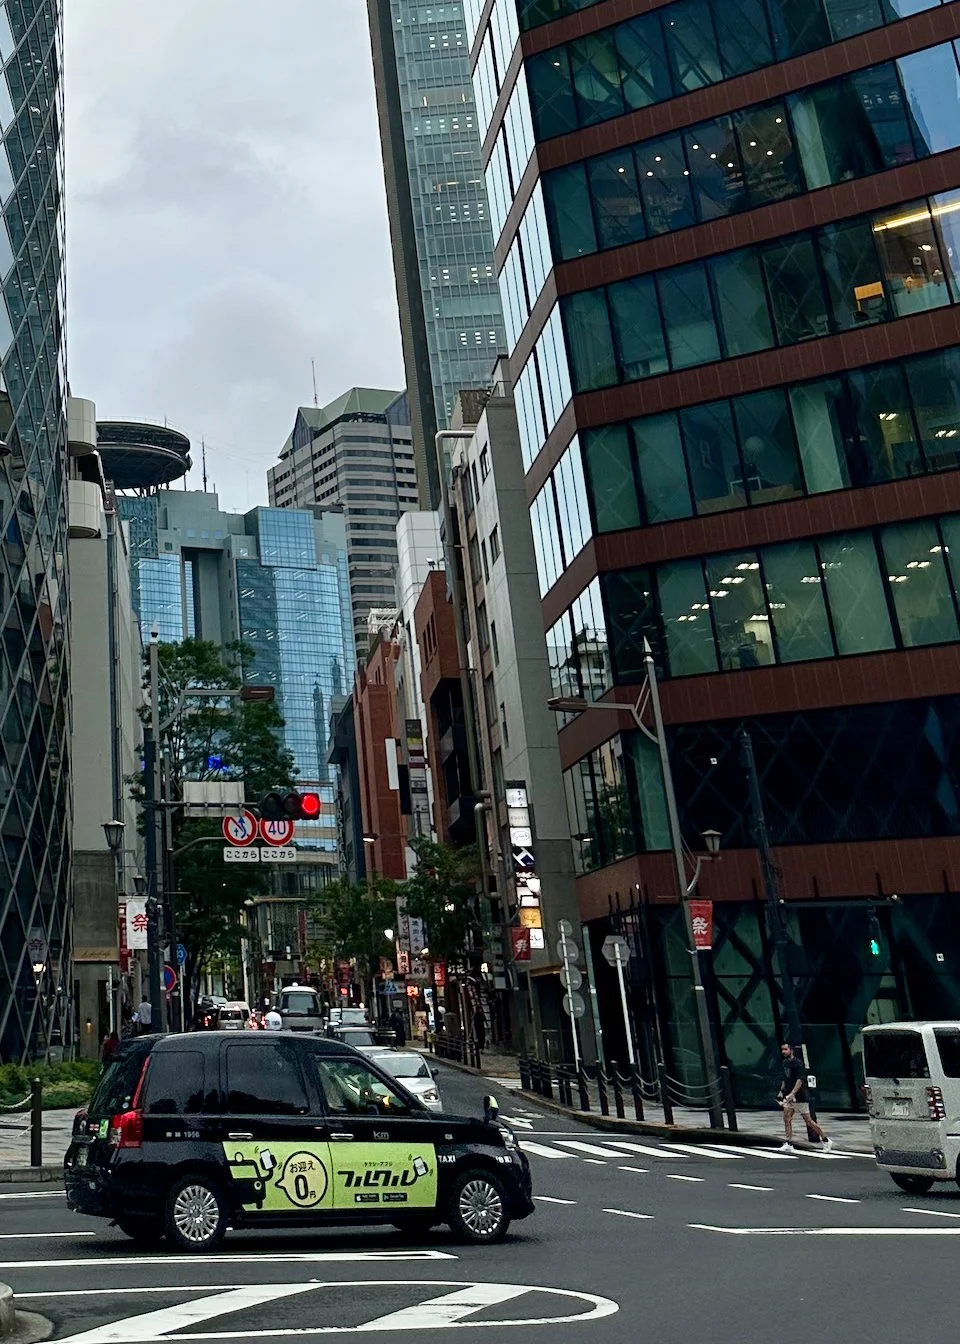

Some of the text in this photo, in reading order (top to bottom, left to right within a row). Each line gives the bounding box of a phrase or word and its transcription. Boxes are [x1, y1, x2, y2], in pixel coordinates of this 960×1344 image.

[268, 820, 287, 836] 40
[225, 850, 258, 859] ここから
[262, 850, 295, 859] ここから
[692, 916, 709, 935] 祭
[437, 1155, 457, 1163] TAXI
[337, 1169, 414, 1188] フルクル
